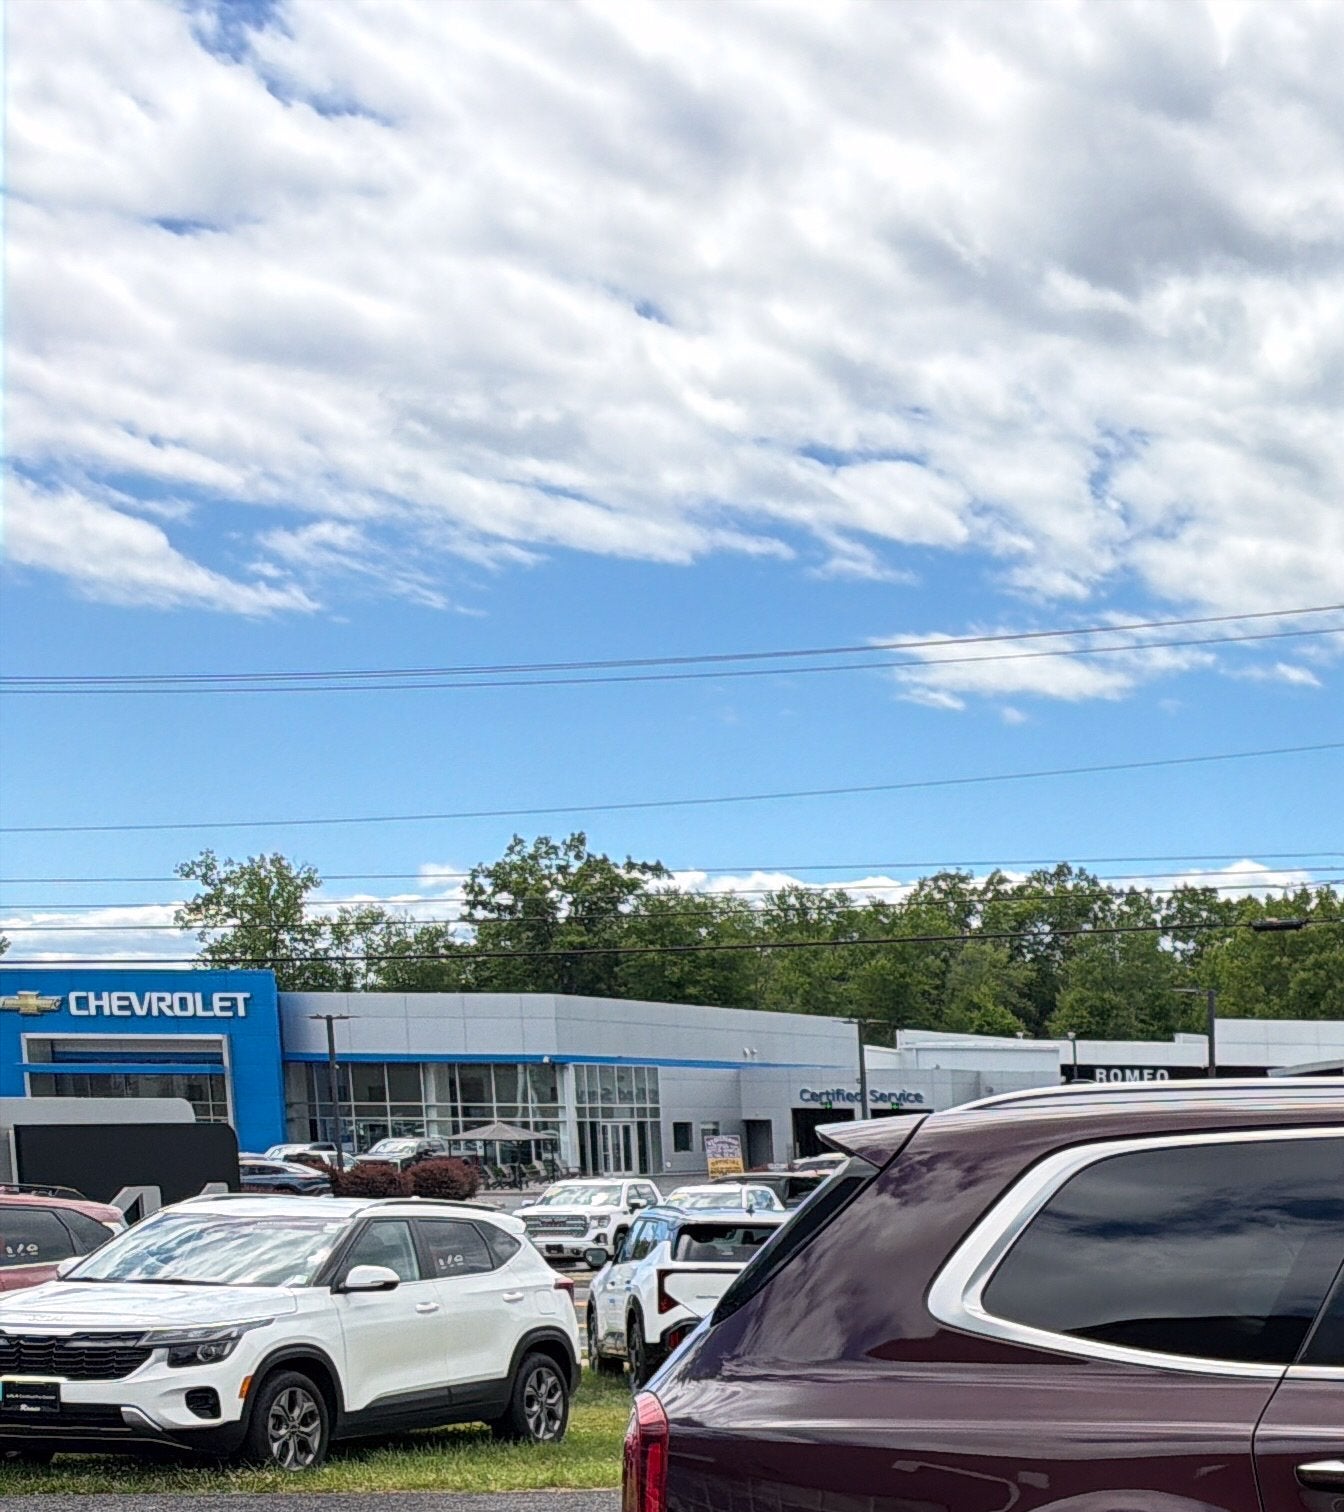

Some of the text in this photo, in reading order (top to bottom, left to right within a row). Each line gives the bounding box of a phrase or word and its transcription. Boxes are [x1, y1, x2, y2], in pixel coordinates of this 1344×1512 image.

[69, 991, 251, 1017] CHEVROLET
[1094, 1068, 1169, 1082] ROMEO
[800, 1088, 924, 1104] Certified Service
